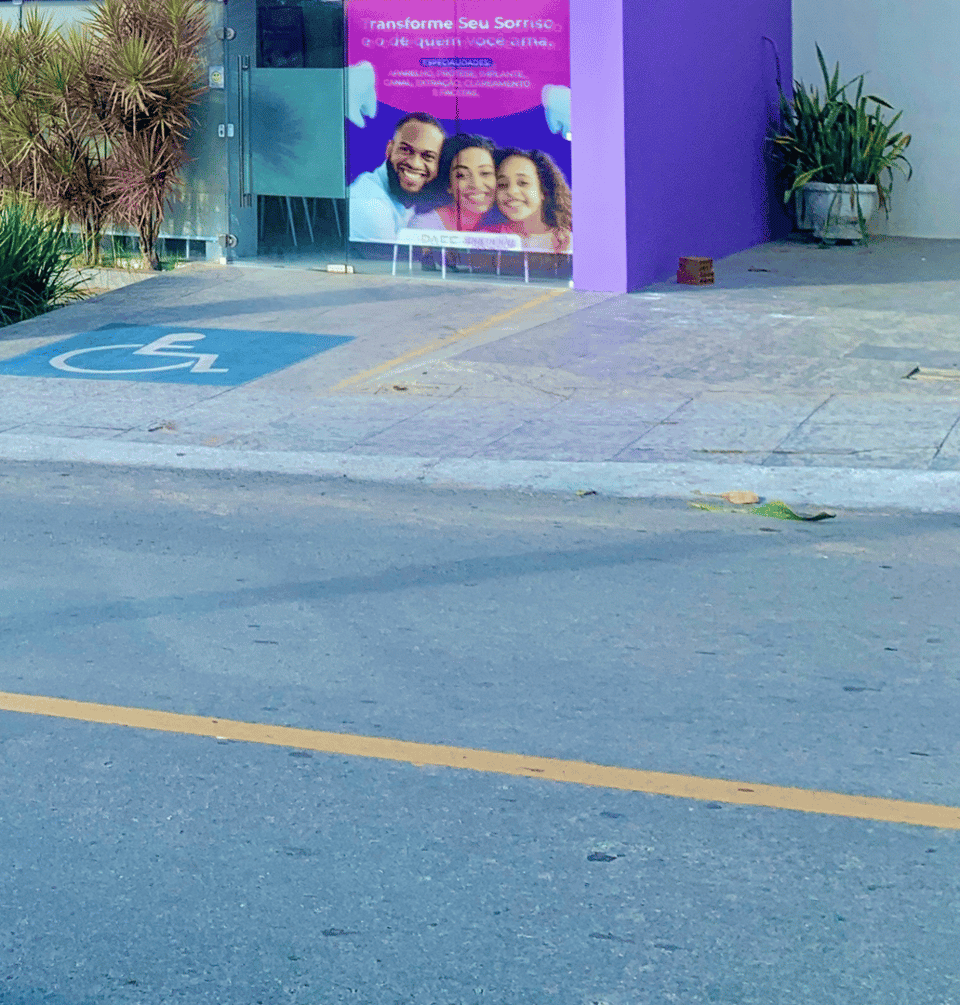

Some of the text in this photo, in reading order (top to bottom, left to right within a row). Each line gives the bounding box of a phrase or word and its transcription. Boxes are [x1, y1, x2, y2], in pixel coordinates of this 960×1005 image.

[361, 16, 555, 31] Transforme Seu Sorriso
